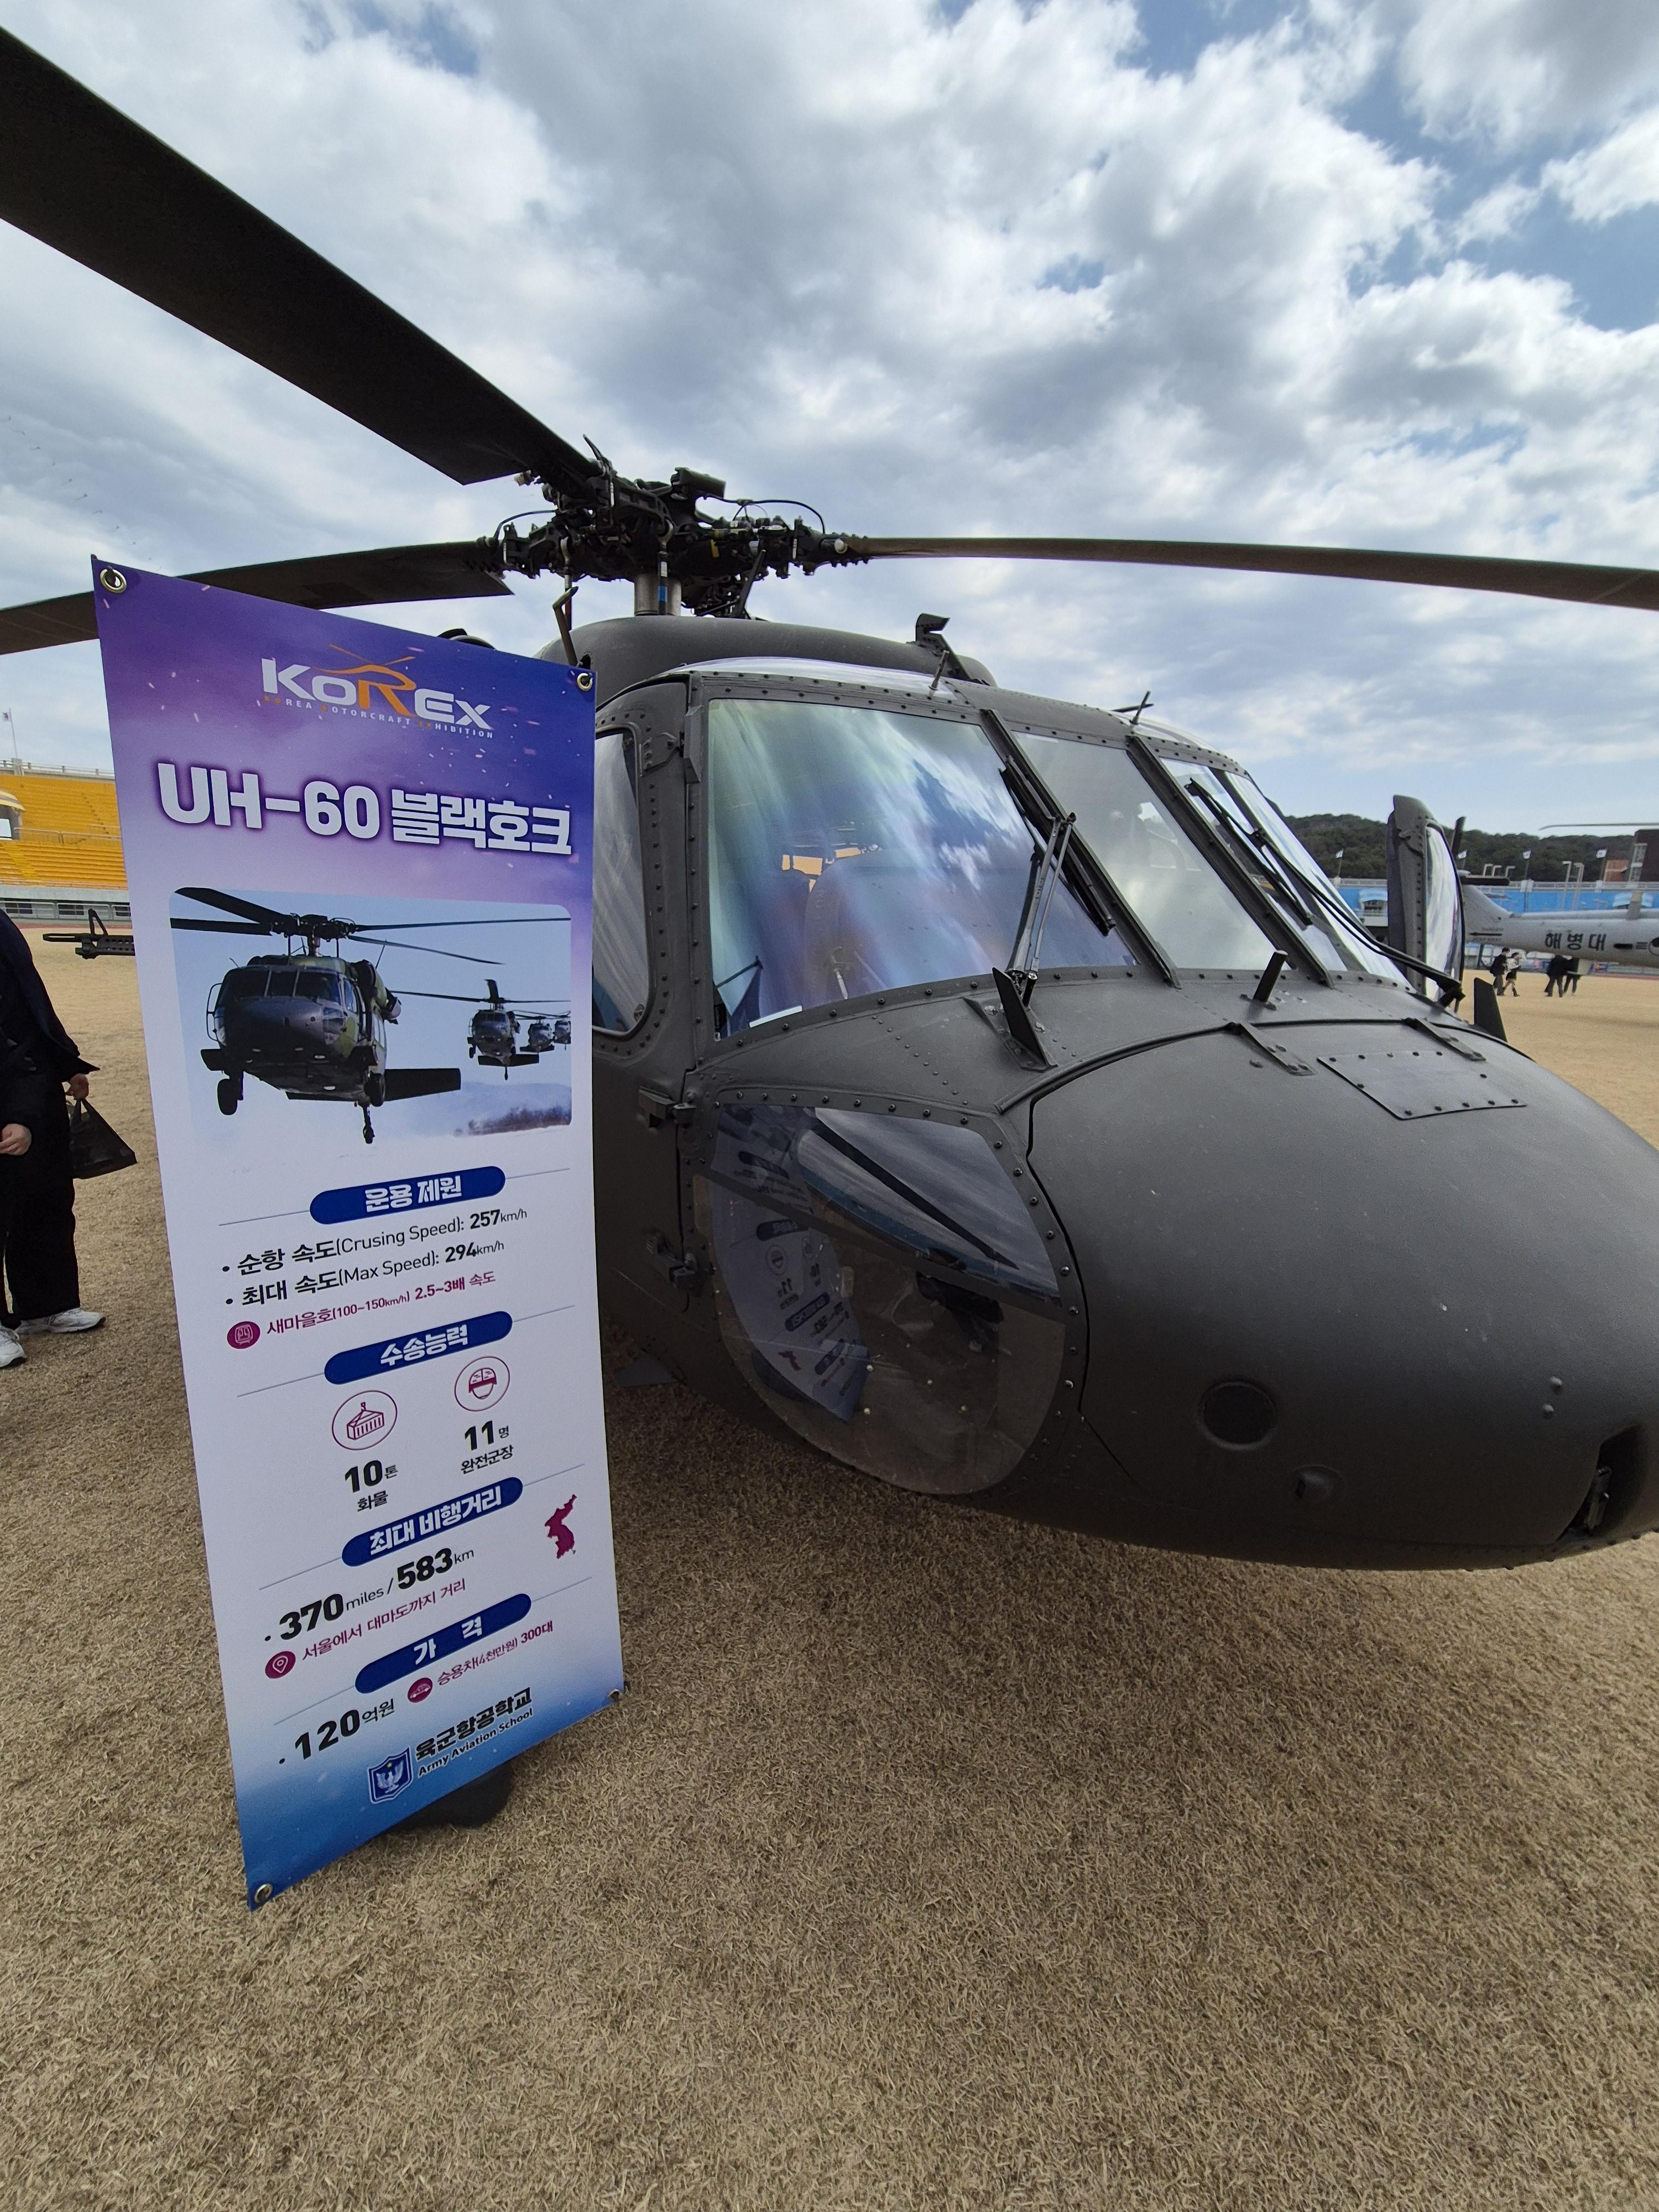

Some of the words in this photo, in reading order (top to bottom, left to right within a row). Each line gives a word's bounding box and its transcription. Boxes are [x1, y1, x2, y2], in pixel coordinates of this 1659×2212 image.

[158, 762, 380, 839] UH-60
[390, 789, 573, 855] 블랙호크
[364, 1184, 413, 1212] 운용
[418, 1175, 462, 1203] 제원
[237, 1248, 285, 1276] 순항
[409, 1217, 465, 1242] Speed):
[470, 1208, 527, 1229] 257km/h
[242, 1280, 288, 1306] 최대
[383, 1250, 440, 1277] Speed):
[445, 1240, 504, 1263] 294km/h
[415, 1277, 465, 1300] 2.5~3배
[469, 1271, 496, 1286] 속도
[380, 1324, 469, 1366] 수송능력
[461, 1444, 515, 1475] 완전군장
[357, 1490, 388, 1513] 화물
[369, 1519, 415, 1556] 최대
[420, 1485, 502, 1535] 비행거리
[302, 1624, 362, 1661] 서울에서
[367, 1591, 436, 1630] 대마도까지
[440, 1578, 466, 1599] 거리
[521, 1620, 553, 1644] 300대
[415, 1687, 533, 1760] 육군항공학교
[418, 1754, 450, 1777] Army
[451, 1728, 496, 1759] Aviation
[498, 1708, 534, 1735] School
